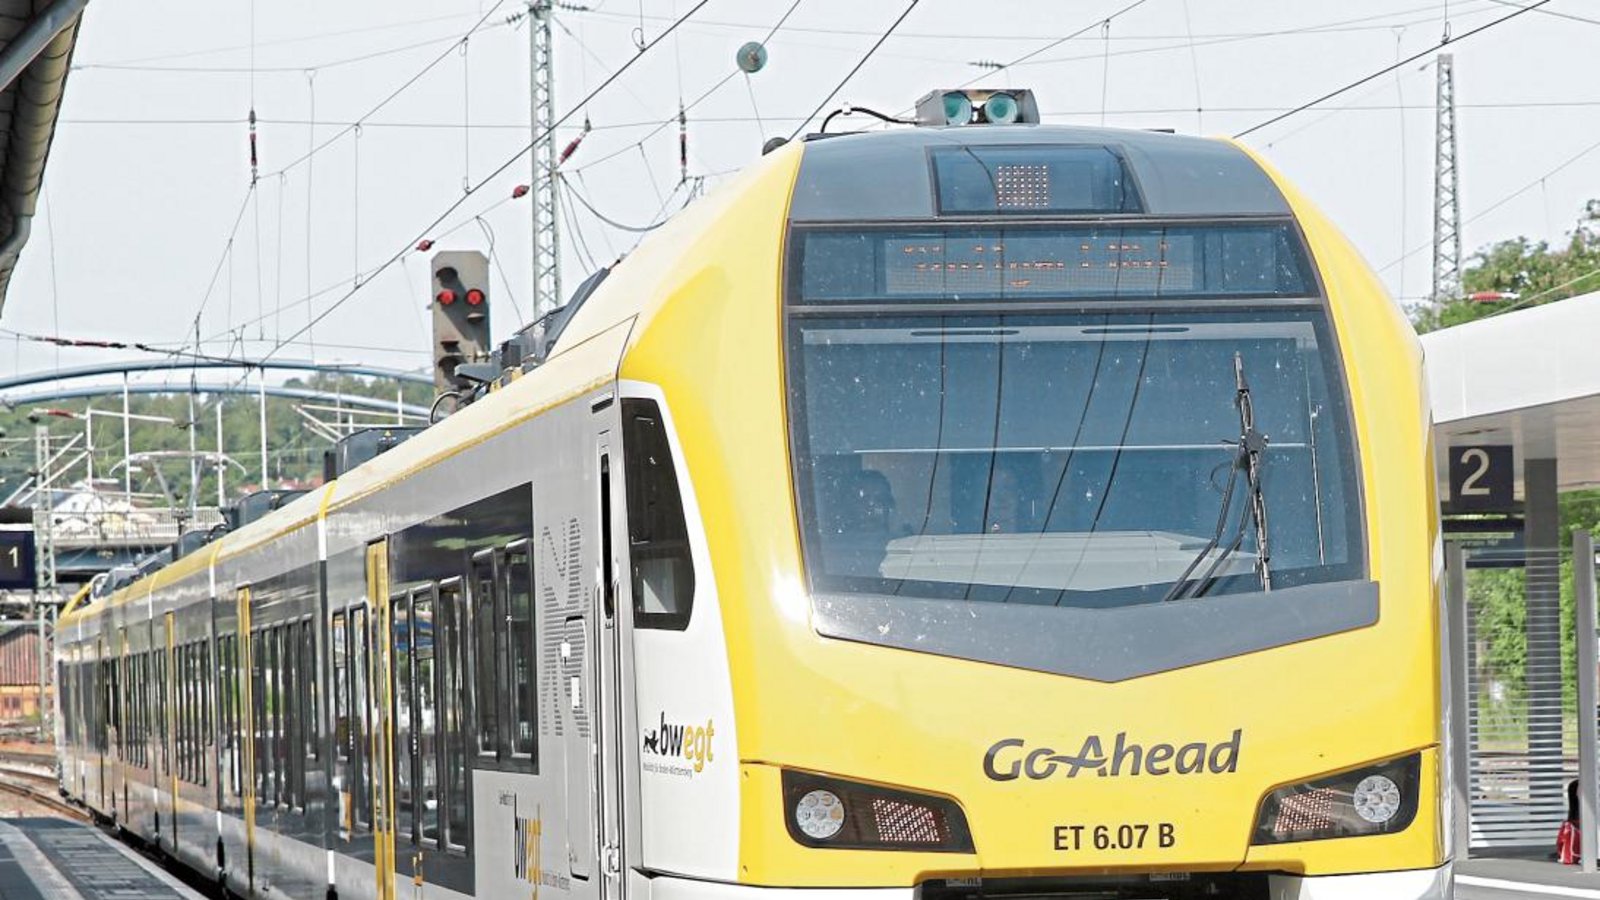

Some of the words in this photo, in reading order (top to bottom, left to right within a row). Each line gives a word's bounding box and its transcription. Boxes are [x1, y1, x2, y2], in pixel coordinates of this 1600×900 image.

[1461, 448, 1490, 495] 2
[8, 546, 18, 568] 1
[660, 711, 714, 773] bwegt
[1053, 825, 1085, 851] ET
[1093, 824, 1149, 850] 6.07
[1158, 823, 1176, 848] B
